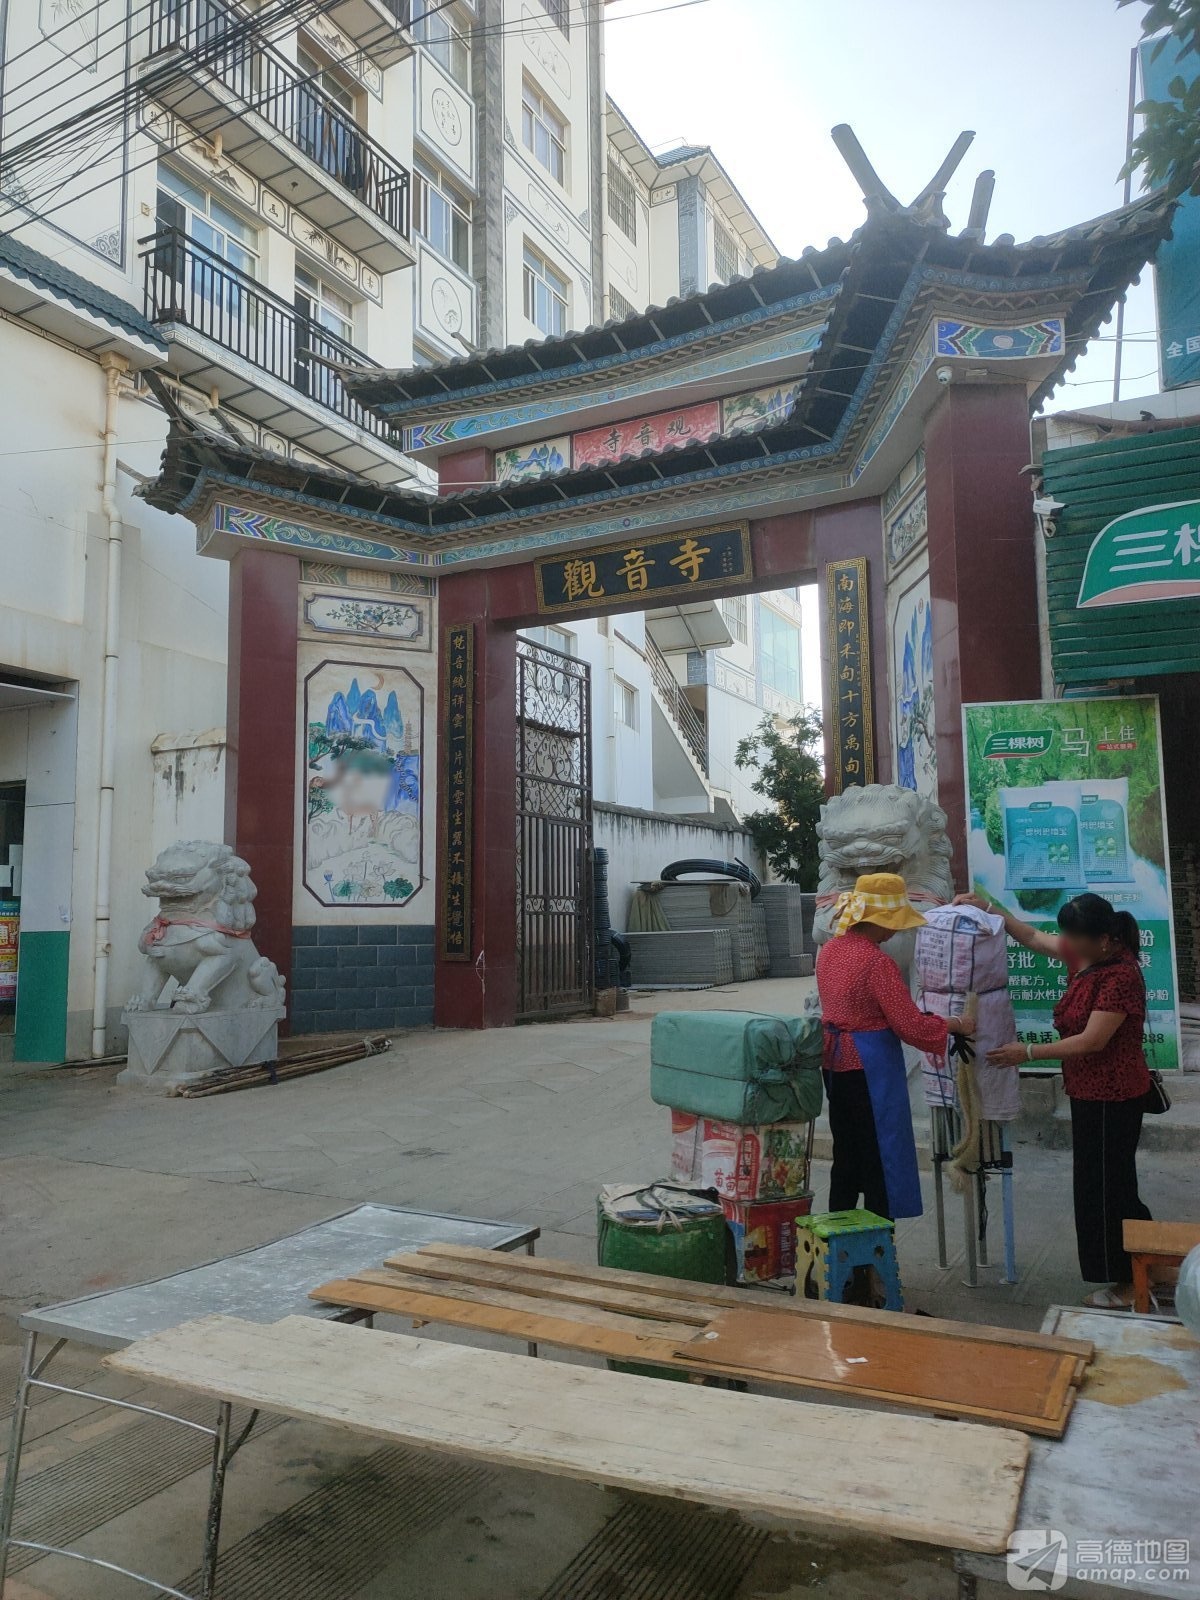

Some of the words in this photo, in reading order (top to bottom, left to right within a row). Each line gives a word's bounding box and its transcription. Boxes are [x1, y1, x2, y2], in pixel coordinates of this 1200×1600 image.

[562, 539, 711, 601] 觀音寺
[837, 573, 860, 788] 南海即禾甸十方禹甸
[991, 736, 1044, 750] 三棵树
